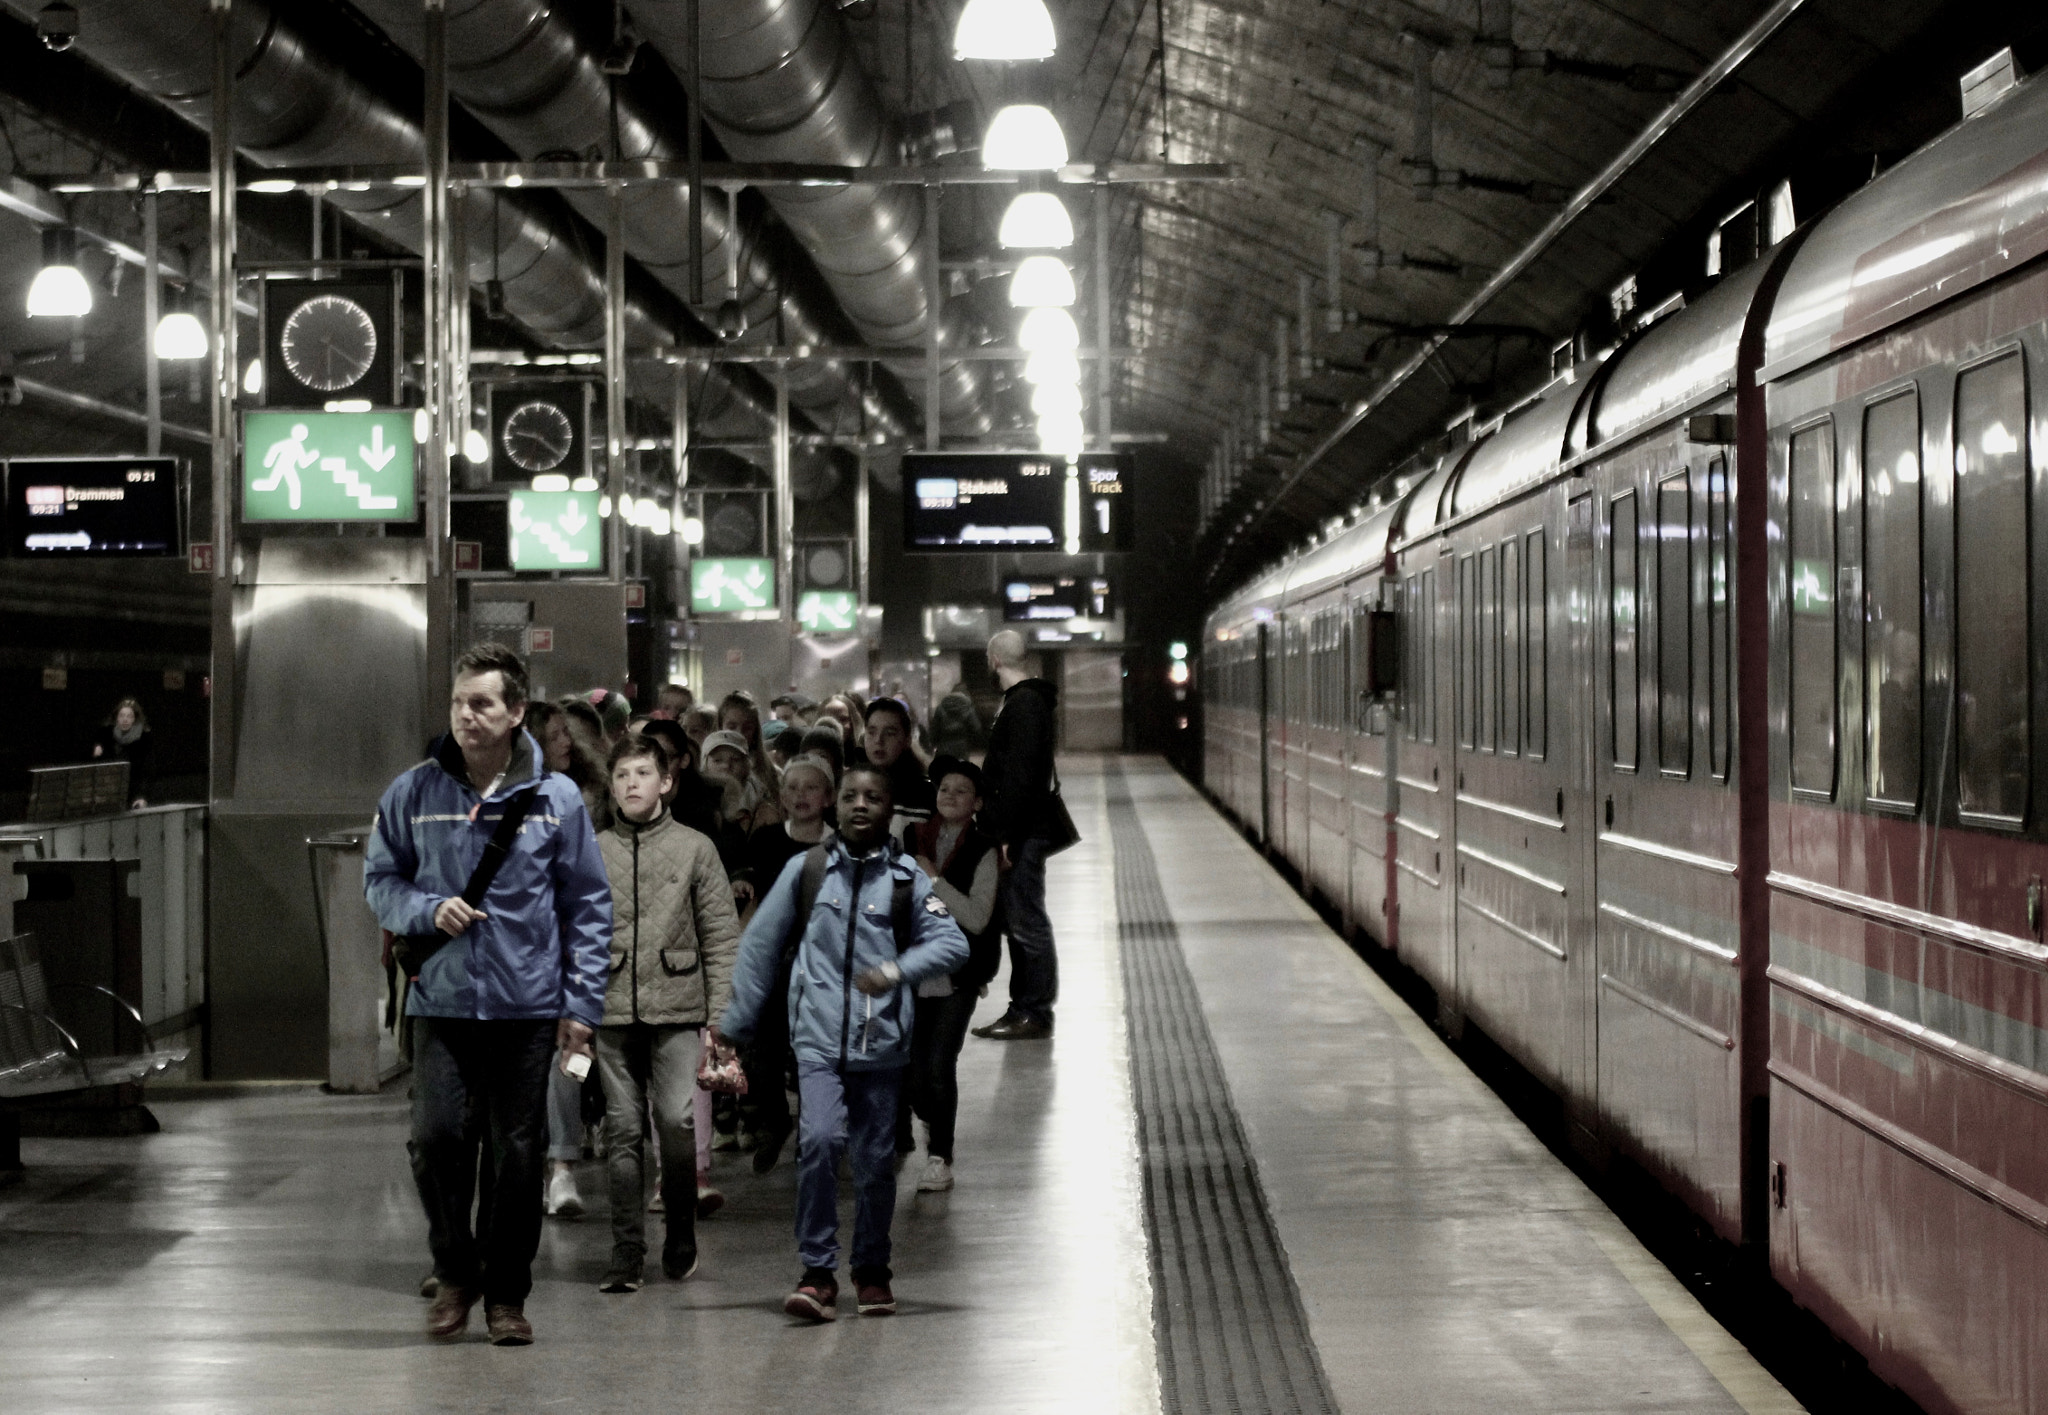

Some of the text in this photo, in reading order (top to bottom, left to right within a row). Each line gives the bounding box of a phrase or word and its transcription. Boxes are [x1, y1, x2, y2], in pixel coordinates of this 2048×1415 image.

[1089, 468, 1119, 482] Spor
[66, 486, 124, 501] Drammen
[958, 479, 1009, 495] Stabekk
[1090, 481, 1122, 494] Track
[32, 503, 60, 515] 09:21
[1096, 499, 1110, 534] 1
